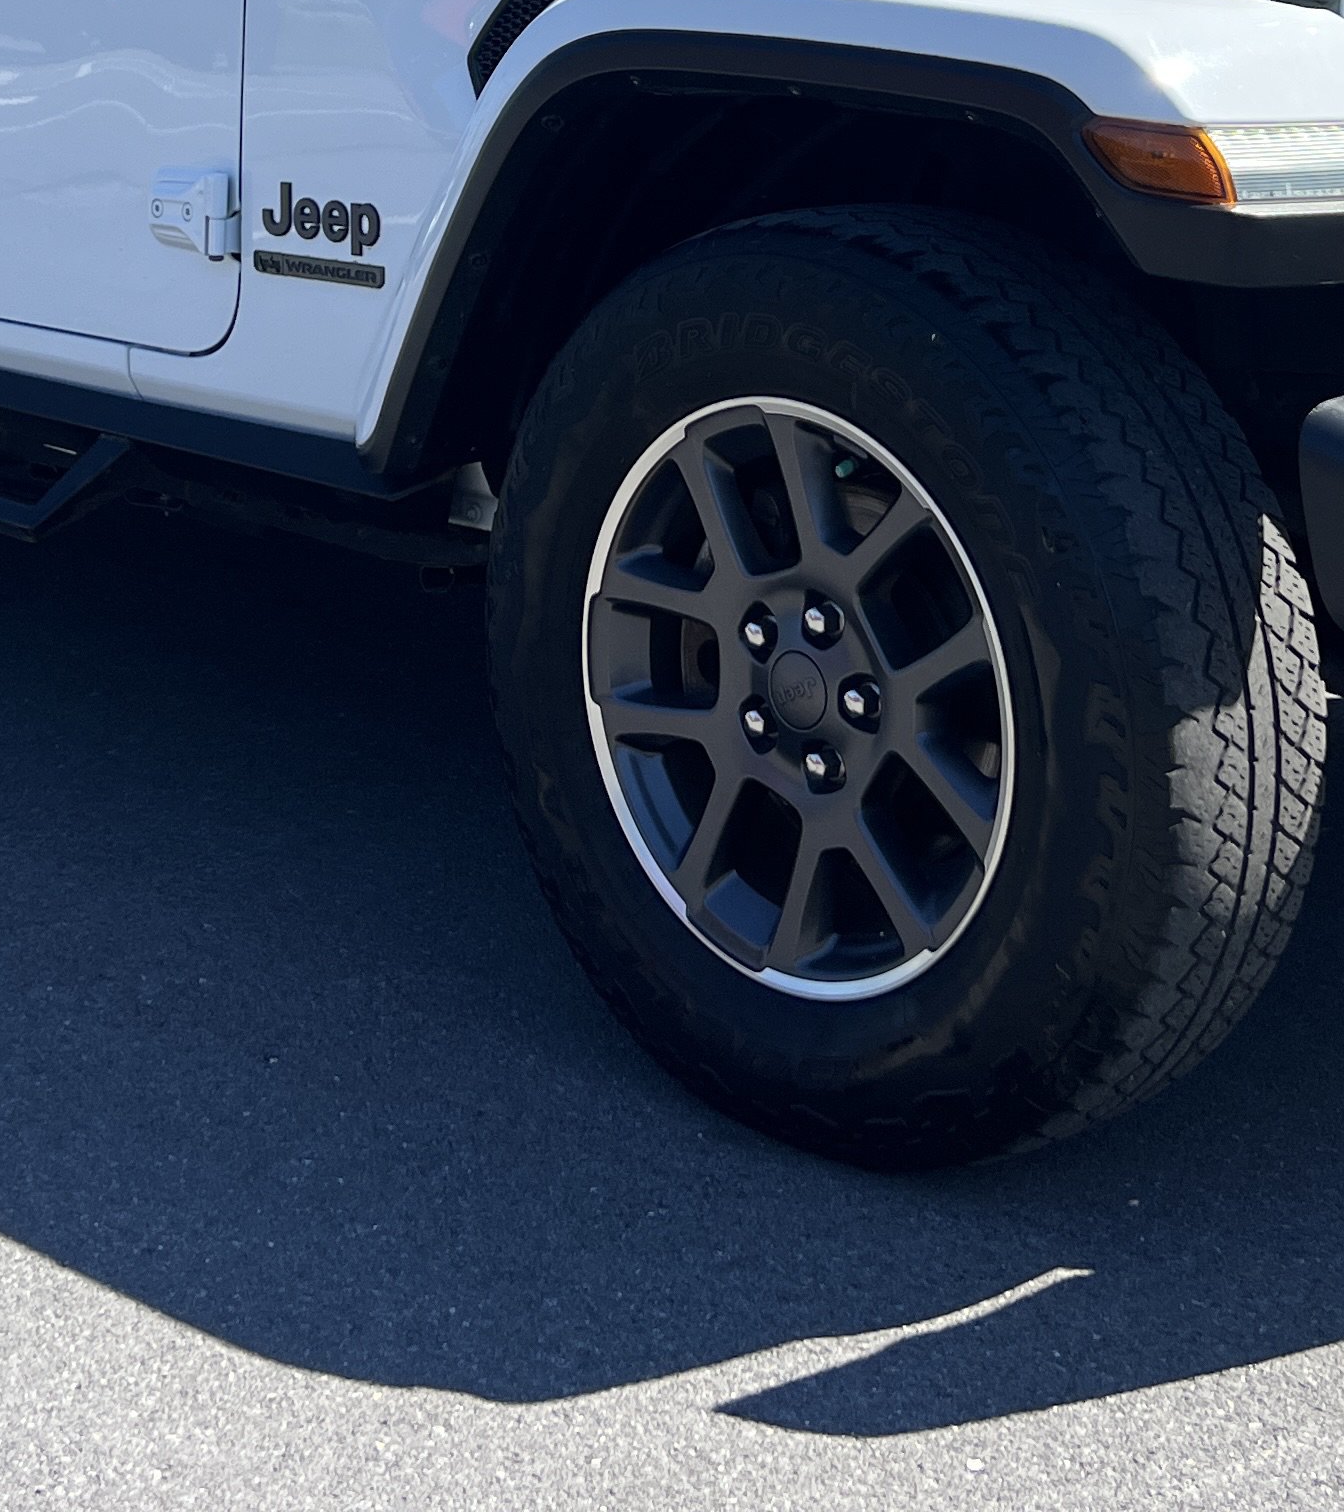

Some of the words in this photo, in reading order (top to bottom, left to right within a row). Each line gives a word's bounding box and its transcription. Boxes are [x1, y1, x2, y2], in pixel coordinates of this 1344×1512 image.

[261, 181, 381, 257] Jeep
[284, 257, 379, 284] WRANGLER
[774, 676, 818, 706] Jeep
